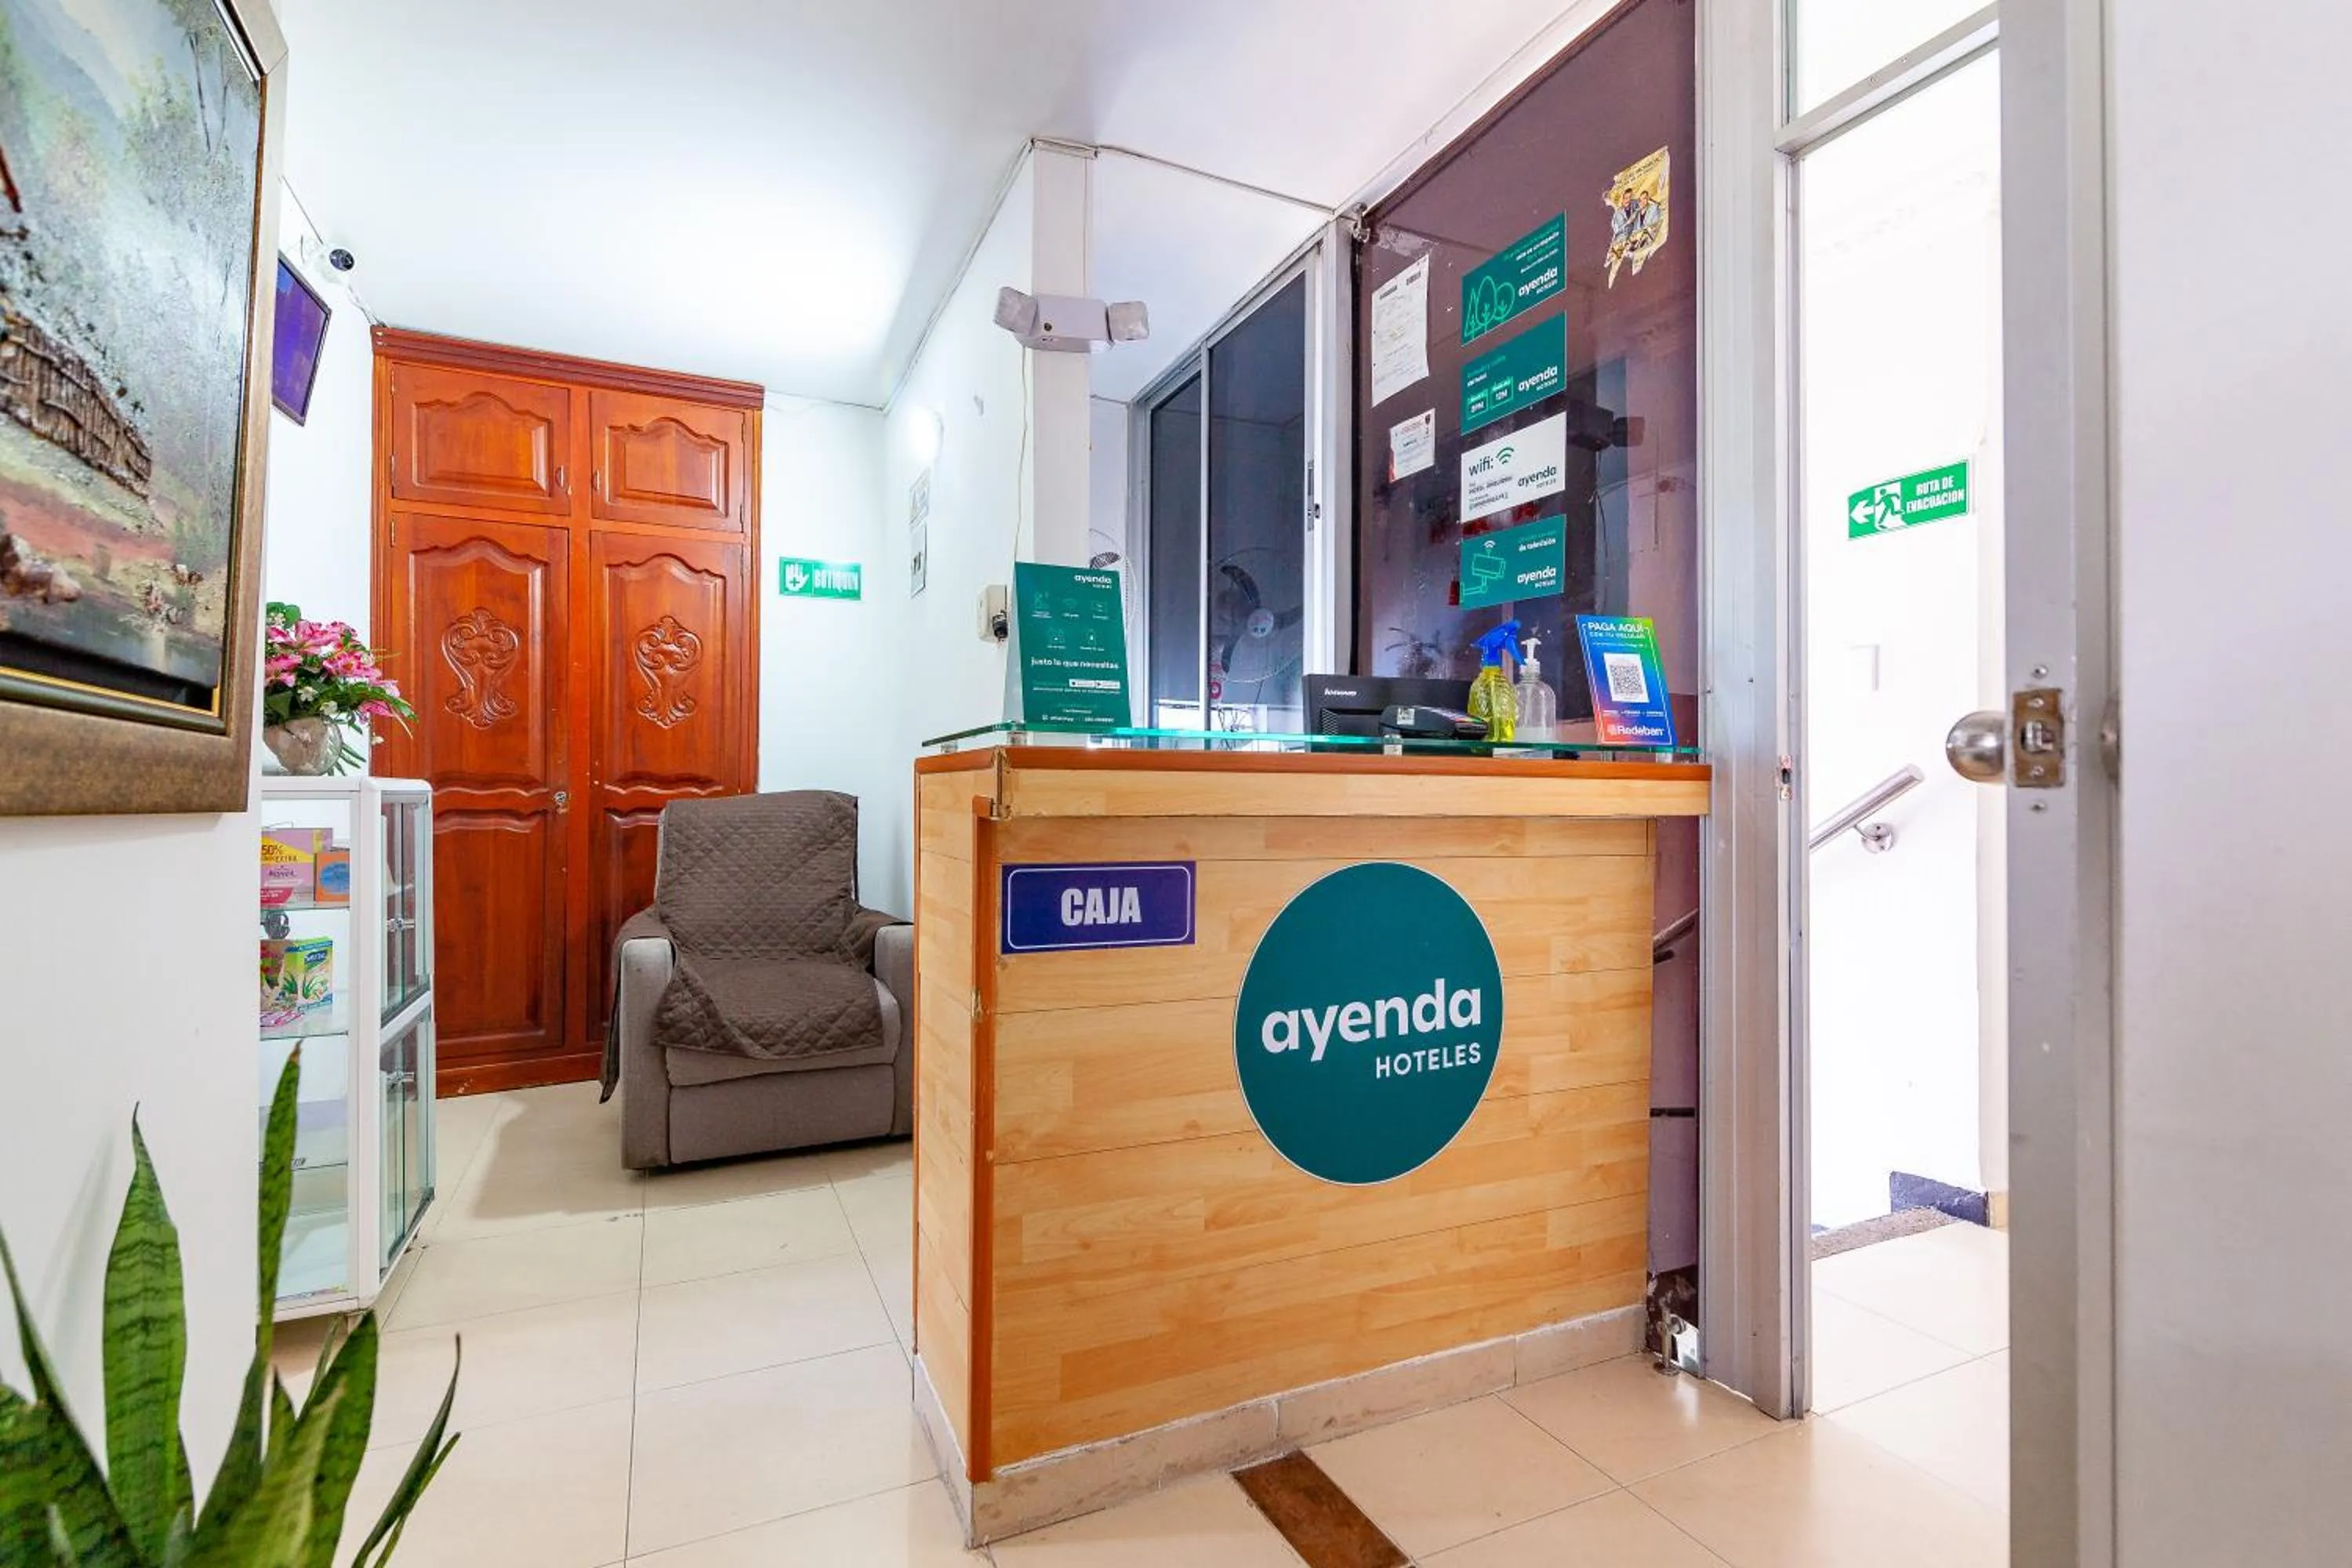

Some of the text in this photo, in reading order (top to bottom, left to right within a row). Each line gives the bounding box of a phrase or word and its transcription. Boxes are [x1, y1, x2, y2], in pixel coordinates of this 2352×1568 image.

[1518, 266, 1558, 296] ayenda
[1518, 365, 1558, 391] ayenda
[1468, 456, 1494, 477] wifi:
[1518, 465, 1556, 488] ayenda
[1915, 475, 1955, 496] RUTA DE
[1073, 573, 1112, 586] ayenda
[1517, 565, 1557, 586] ayenda
[1588, 622, 1615, 631] PAGA
[1030, 656, 1053, 666] justo
[1080, 660, 1120, 670] necesitas
[1617, 724, 1664, 736] Redeban
[1060, 887, 1142, 926] CAJA
[1261, 978, 1481, 1062] ayenda
[1376, 1042, 1481, 1079] HOTELES
